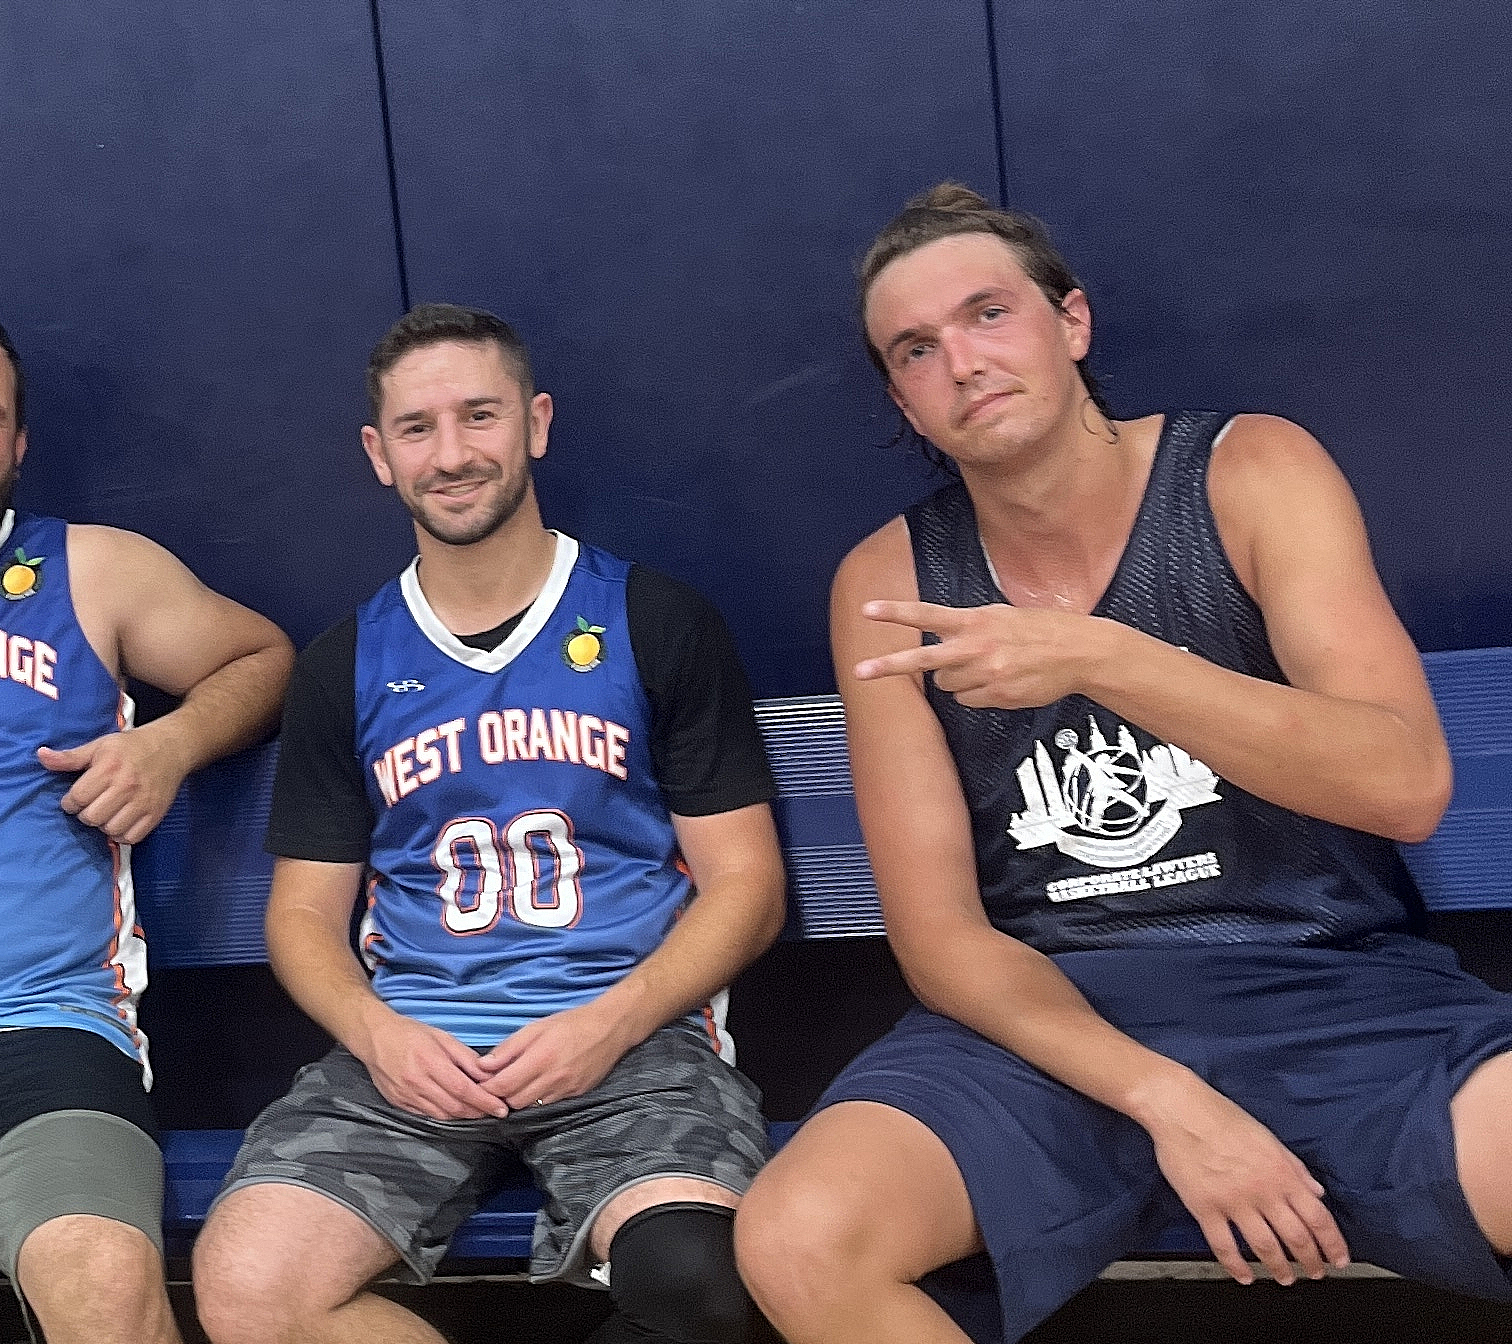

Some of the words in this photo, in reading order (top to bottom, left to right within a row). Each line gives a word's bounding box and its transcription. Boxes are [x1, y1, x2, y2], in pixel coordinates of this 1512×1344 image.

[372, 718, 467, 808] WEST
[478, 708, 630, 781] ORANGE
[431, 808, 585, 937] 00
